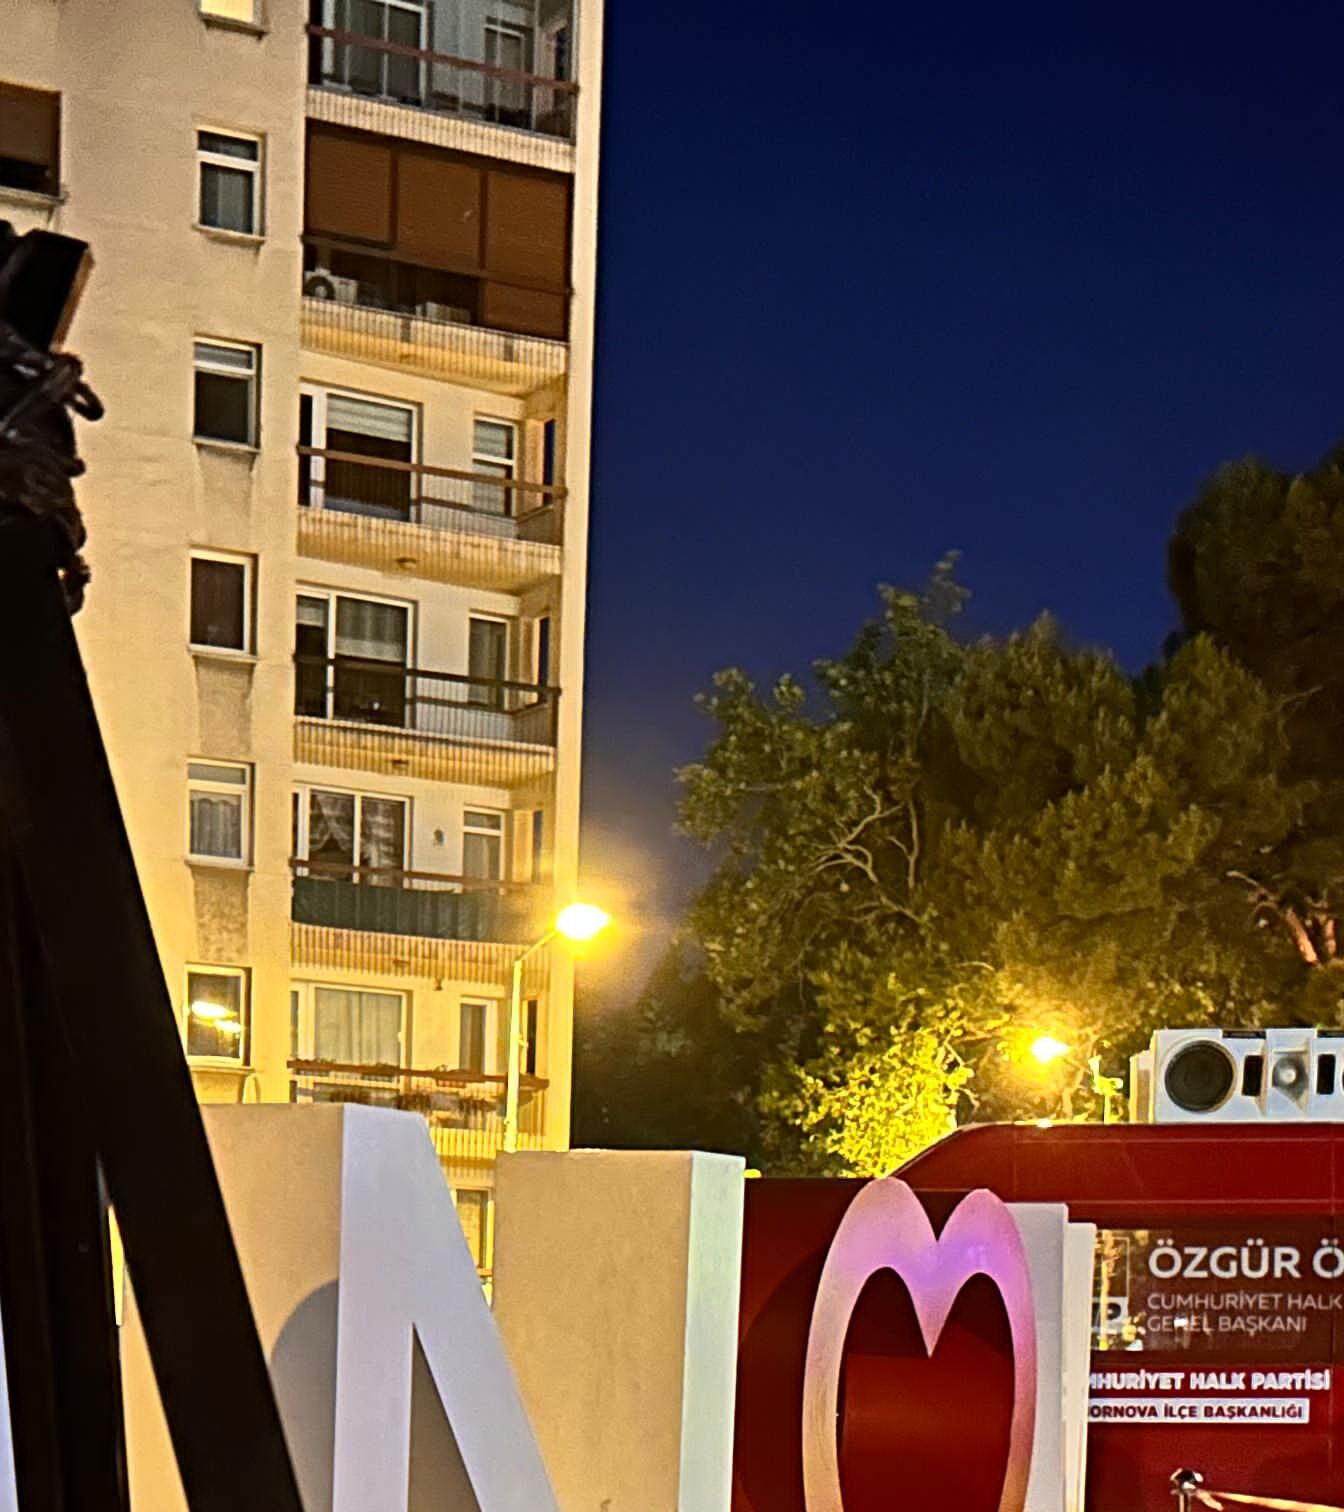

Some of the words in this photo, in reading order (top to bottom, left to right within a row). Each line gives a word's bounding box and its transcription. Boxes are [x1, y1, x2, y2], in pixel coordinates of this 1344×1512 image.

[1147, 1238, 1301, 1279] ÖZGÜR
[1146, 1290, 1283, 1311] CUMHURİYET
[1287, 1294, 1343, 1311] HALK
[1219, 1314, 1308, 1337] BAŞKANI
[1189, 1372, 1246, 1390] HALK
[1251, 1368, 1331, 1390] PARTİSİ
[1088, 1404, 1159, 1419] ORNOVA
[1163, 1402, 1198, 1420] İLÇE
[1203, 1402, 1304, 1421] BAŞKANLIĞI
